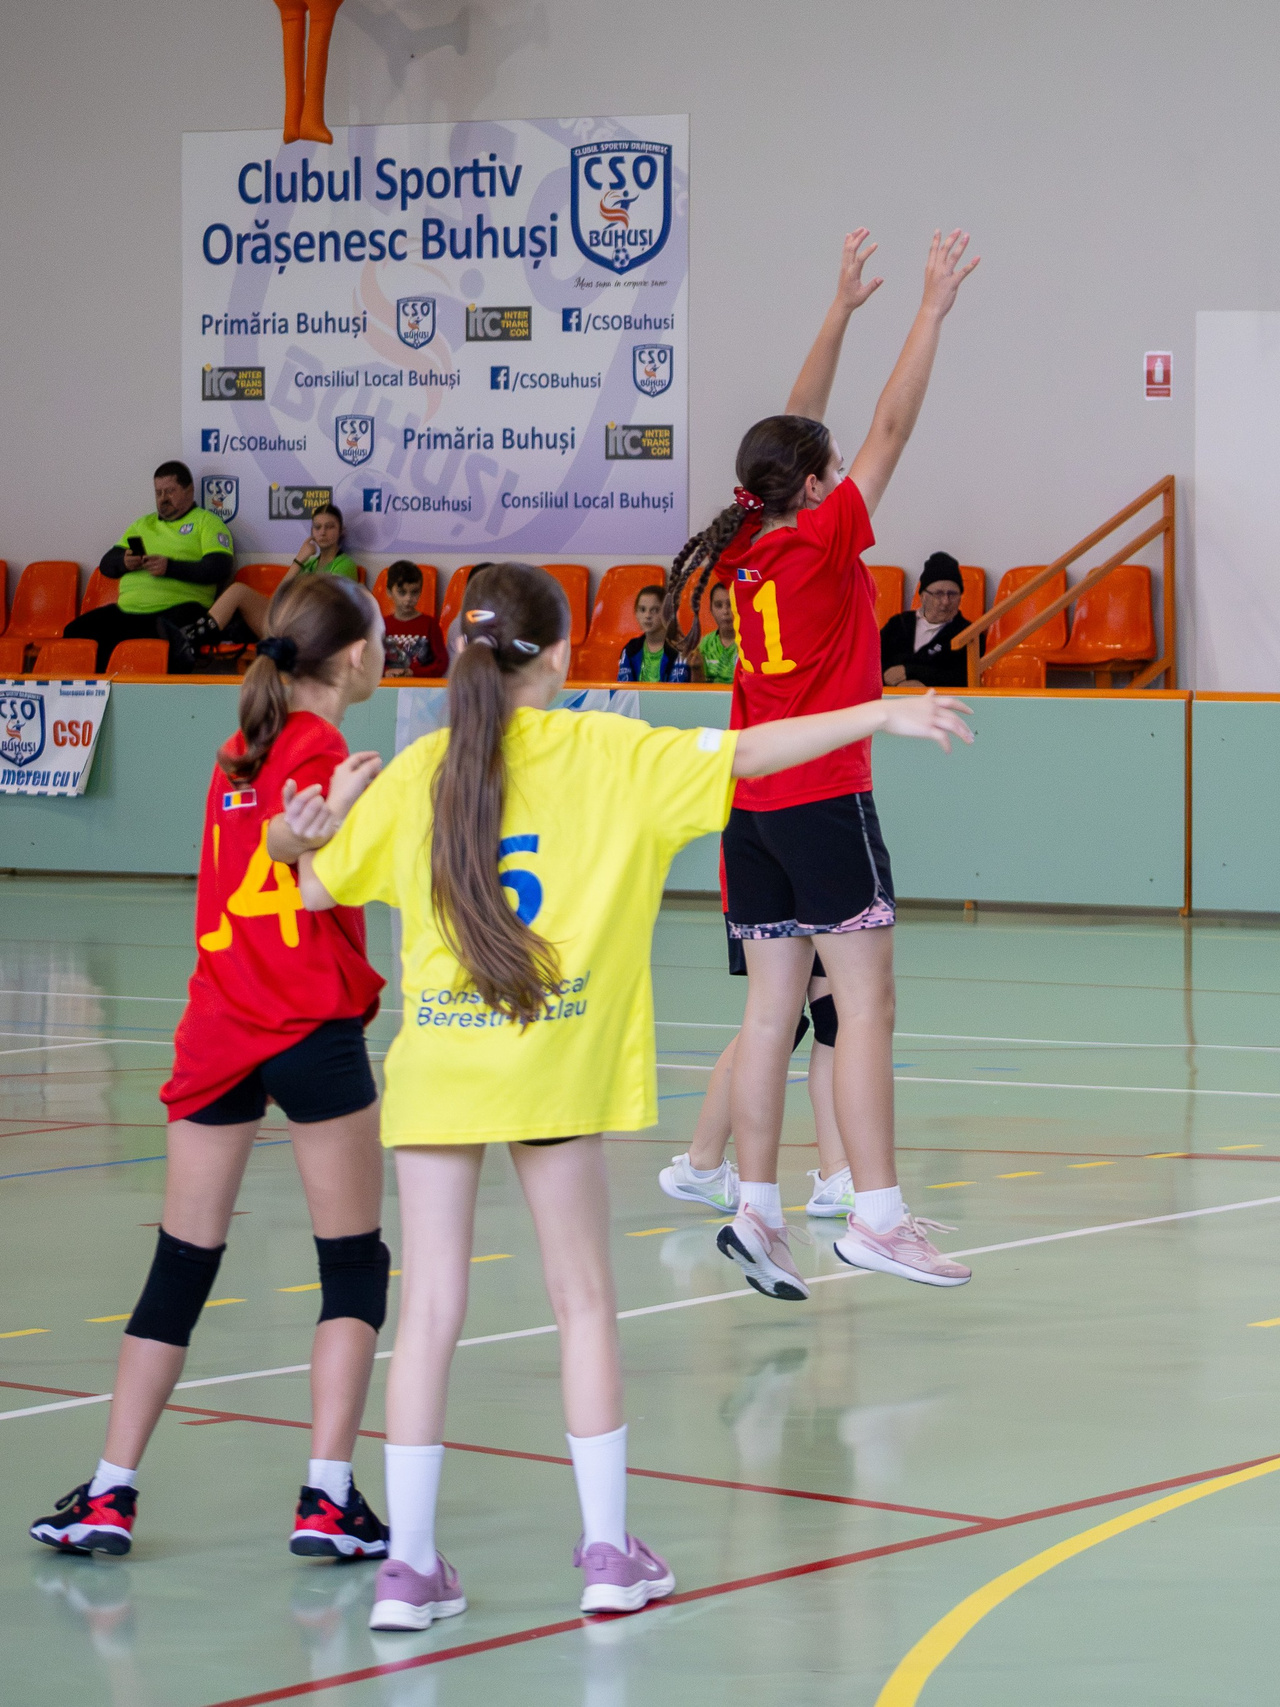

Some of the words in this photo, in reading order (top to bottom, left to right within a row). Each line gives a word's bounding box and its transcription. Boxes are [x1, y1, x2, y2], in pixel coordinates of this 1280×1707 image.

[584, 155, 658, 190] CSO
[238, 156, 362, 205] Clubul
[375, 153, 523, 211] Sportiv
[202, 219, 408, 275] Orășenesc
[422, 213, 559, 270] Buhuși
[402, 302, 430, 317] CSO
[504, 311, 529, 319] INTER
[202, 311, 289, 335] Primăria
[297, 310, 368, 338] Buhuși
[501, 320, 529, 328] TRANS
[509, 328, 529, 337] COM
[638, 350, 667, 364] CSO
[238, 371, 262, 379] INTER
[294, 370, 359, 388] Consiliul
[365, 370, 403, 387] Local
[408, 369, 461, 390] Buhuși
[236, 380, 262, 388] TRANS
[244, 388, 263, 397] COM
[340, 420, 369, 435] CSO
[645, 429, 670, 437] INTER
[403, 426, 494, 450] Primăria
[502, 426, 576, 456] Buhuși
[642, 438, 670, 446] TRANS
[651, 447, 670, 455] COM
[206, 480, 234, 495] CSO
[306, 490, 330, 499] INTER
[501, 492, 569, 509] Consiliul
[574, 492, 614, 508] Local
[620, 492, 674, 512] Buhuși
[53, 719, 93, 747] CSO
[1, 769, 51, 786] mereu
[53, 771, 71, 787] cu
